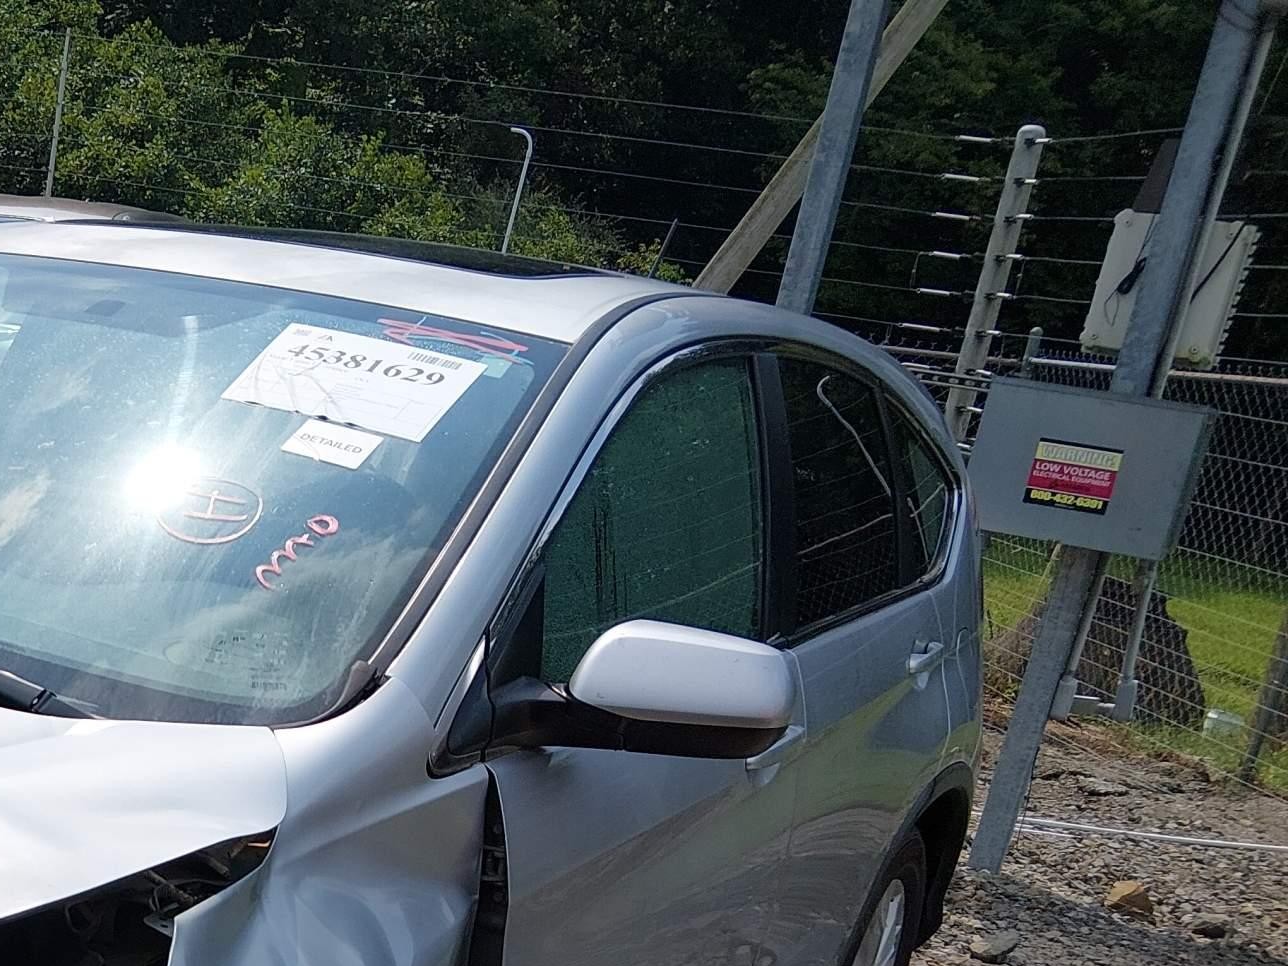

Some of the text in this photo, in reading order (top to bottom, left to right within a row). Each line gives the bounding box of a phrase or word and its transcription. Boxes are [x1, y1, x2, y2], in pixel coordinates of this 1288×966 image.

[287, 343, 445, 386] 45381629
[299, 432, 362, 454] DETAILED
[1033, 470, 1110, 486] ELECTRICAL EQUIPMENT
[1035, 462, 1111, 480] LOW VOLTAGE
